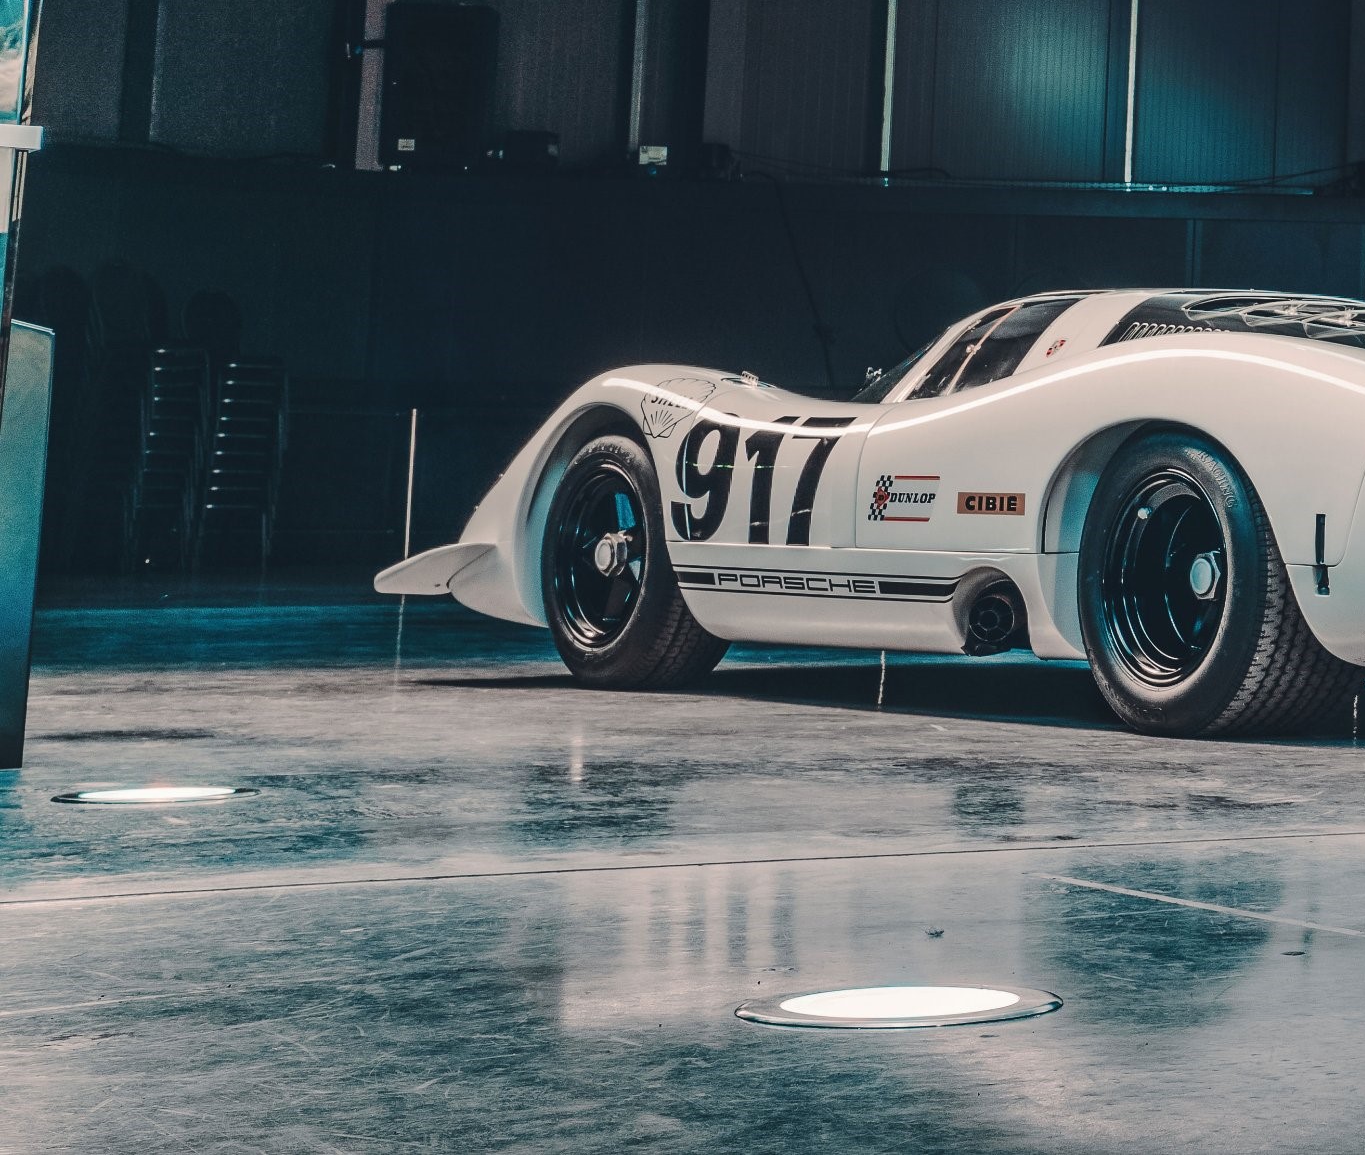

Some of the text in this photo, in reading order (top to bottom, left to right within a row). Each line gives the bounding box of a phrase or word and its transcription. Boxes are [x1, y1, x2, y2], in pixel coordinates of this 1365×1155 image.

[670, 412, 858, 547] 917
[888, 492, 937, 504] DUNLOP
[965, 495, 1018, 512] CIBIE
[717, 572, 878, 595] PORSCHE
